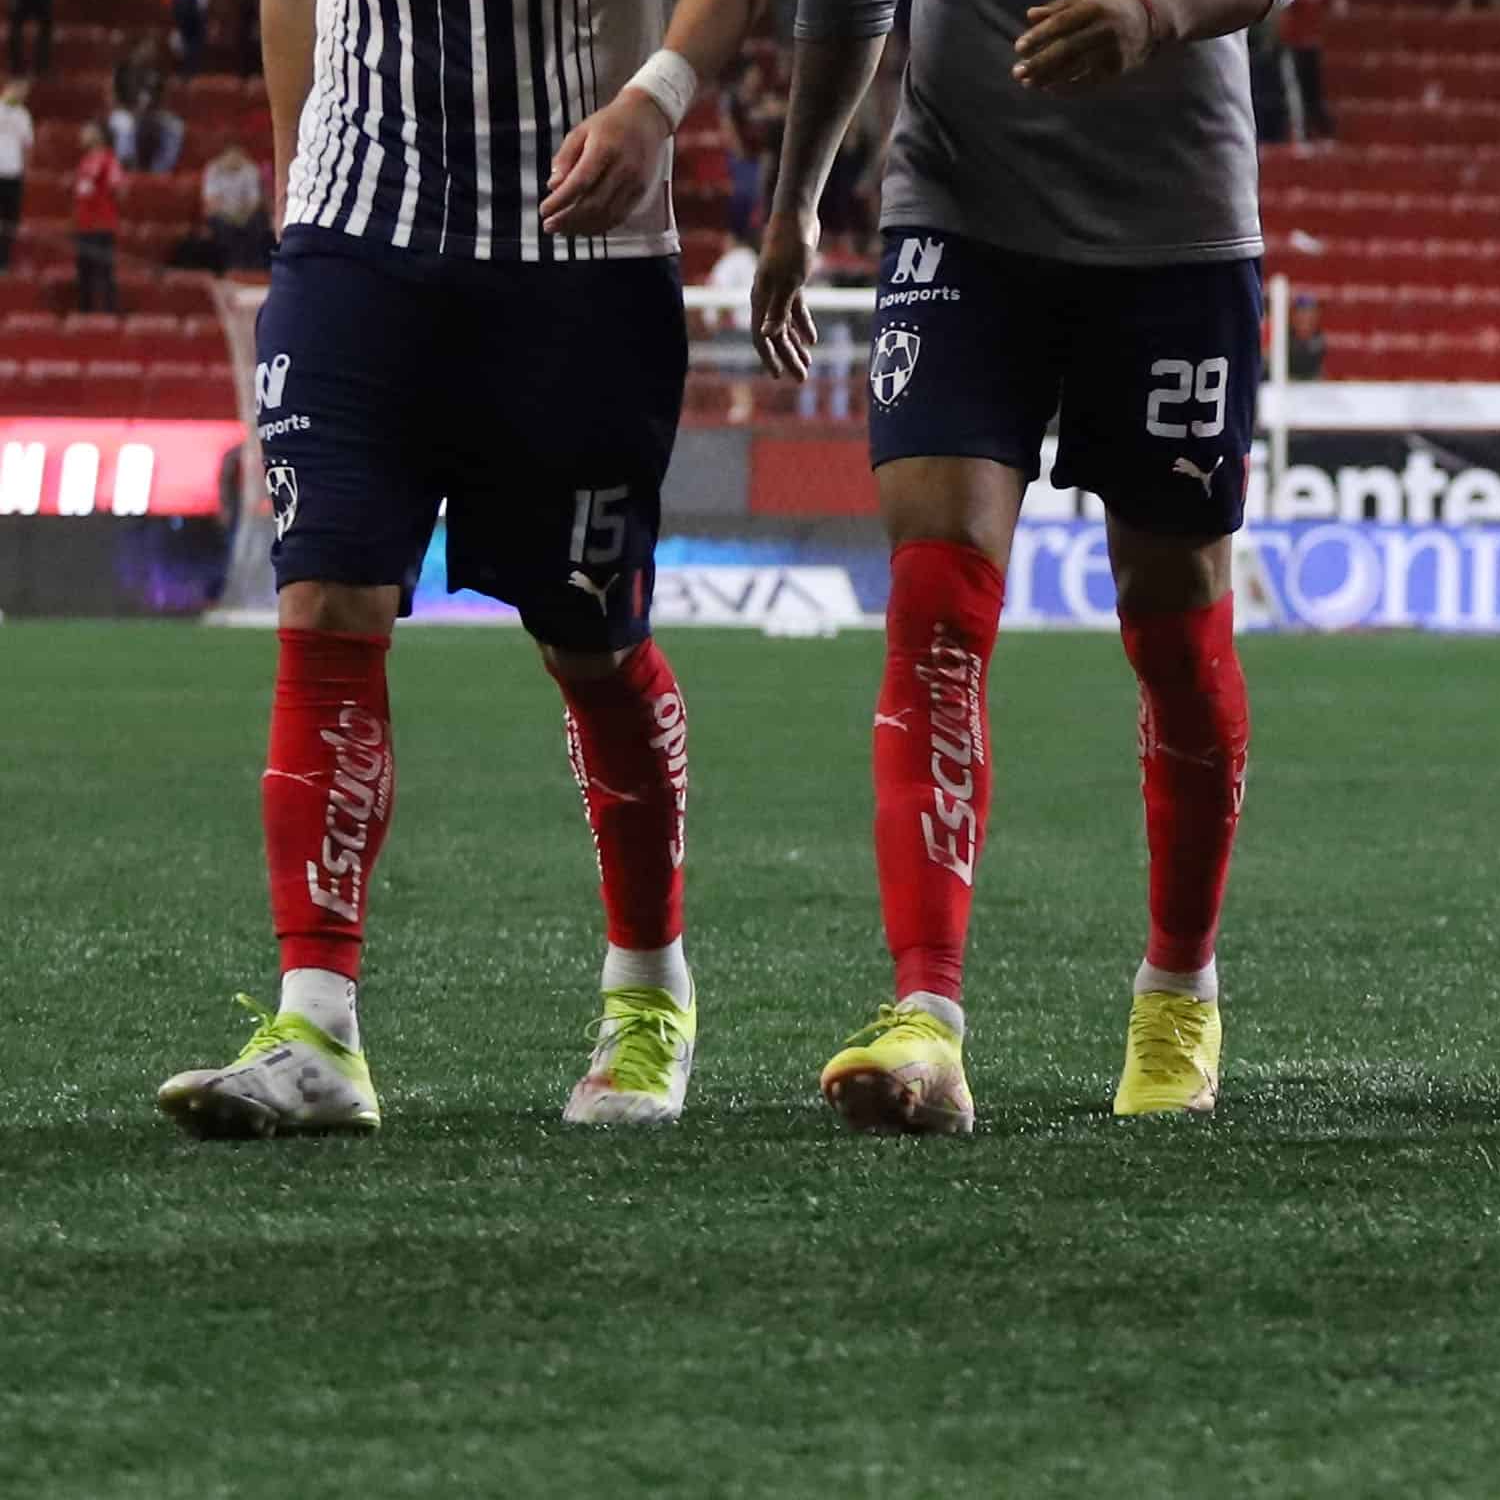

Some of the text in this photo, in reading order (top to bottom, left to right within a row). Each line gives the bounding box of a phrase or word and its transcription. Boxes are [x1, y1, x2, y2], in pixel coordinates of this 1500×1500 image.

[879, 284, 961, 310] nowports
[1146, 356, 1229, 439] 29
[567, 487, 628, 566] 15
